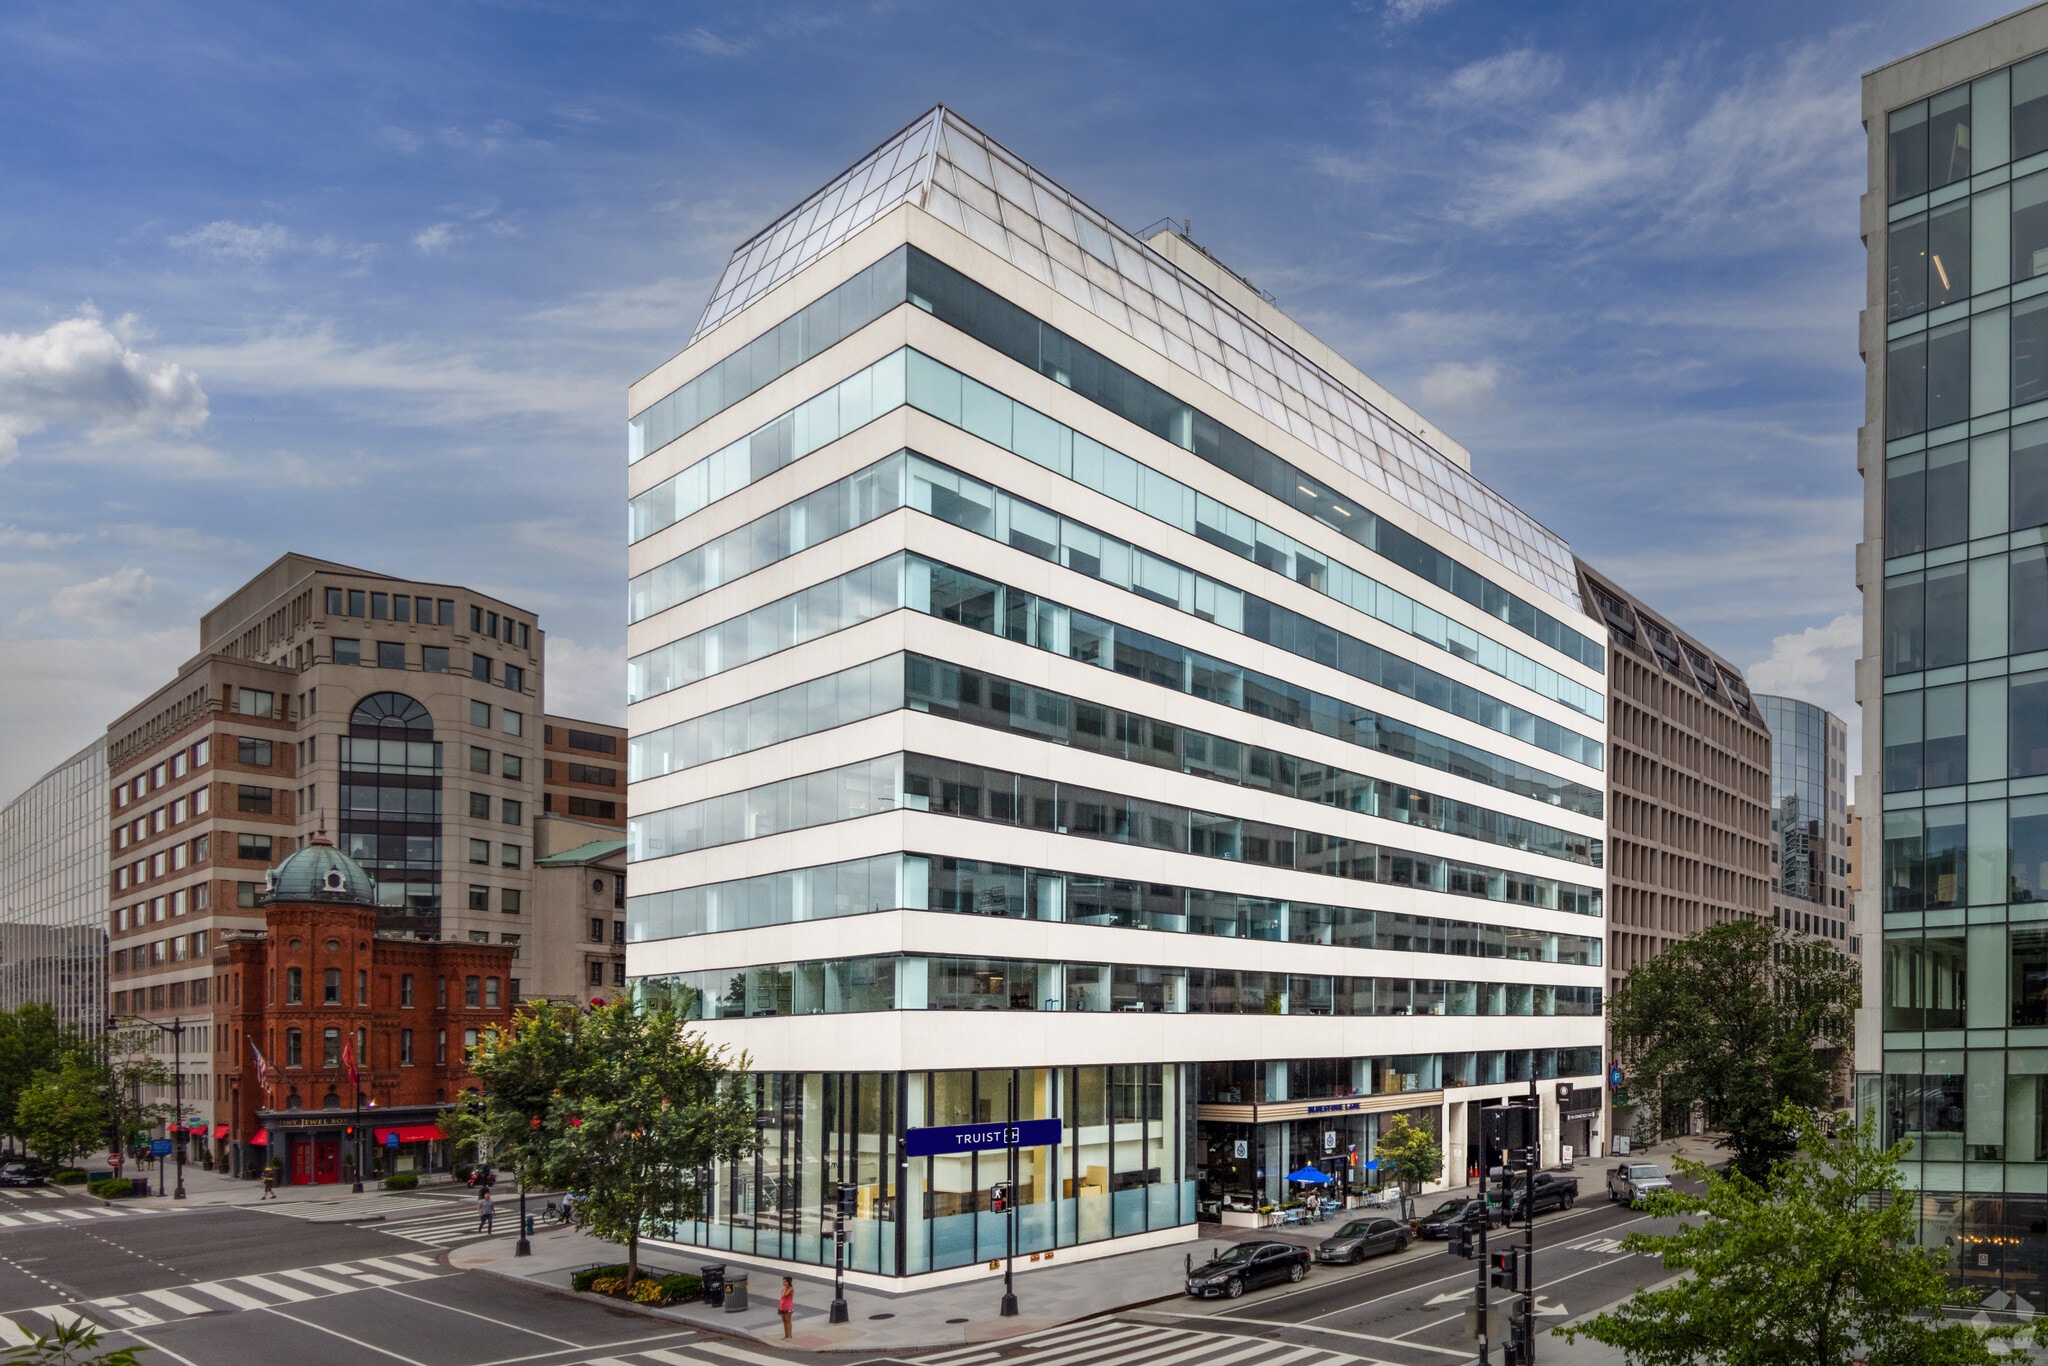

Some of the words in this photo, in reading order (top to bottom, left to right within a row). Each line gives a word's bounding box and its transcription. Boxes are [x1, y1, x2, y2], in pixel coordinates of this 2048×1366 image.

[1614, 1072, 1620, 1081] P
[300, 1118, 328, 1128] JEWEL
[955, 1131, 1001, 1145] TRUIST
